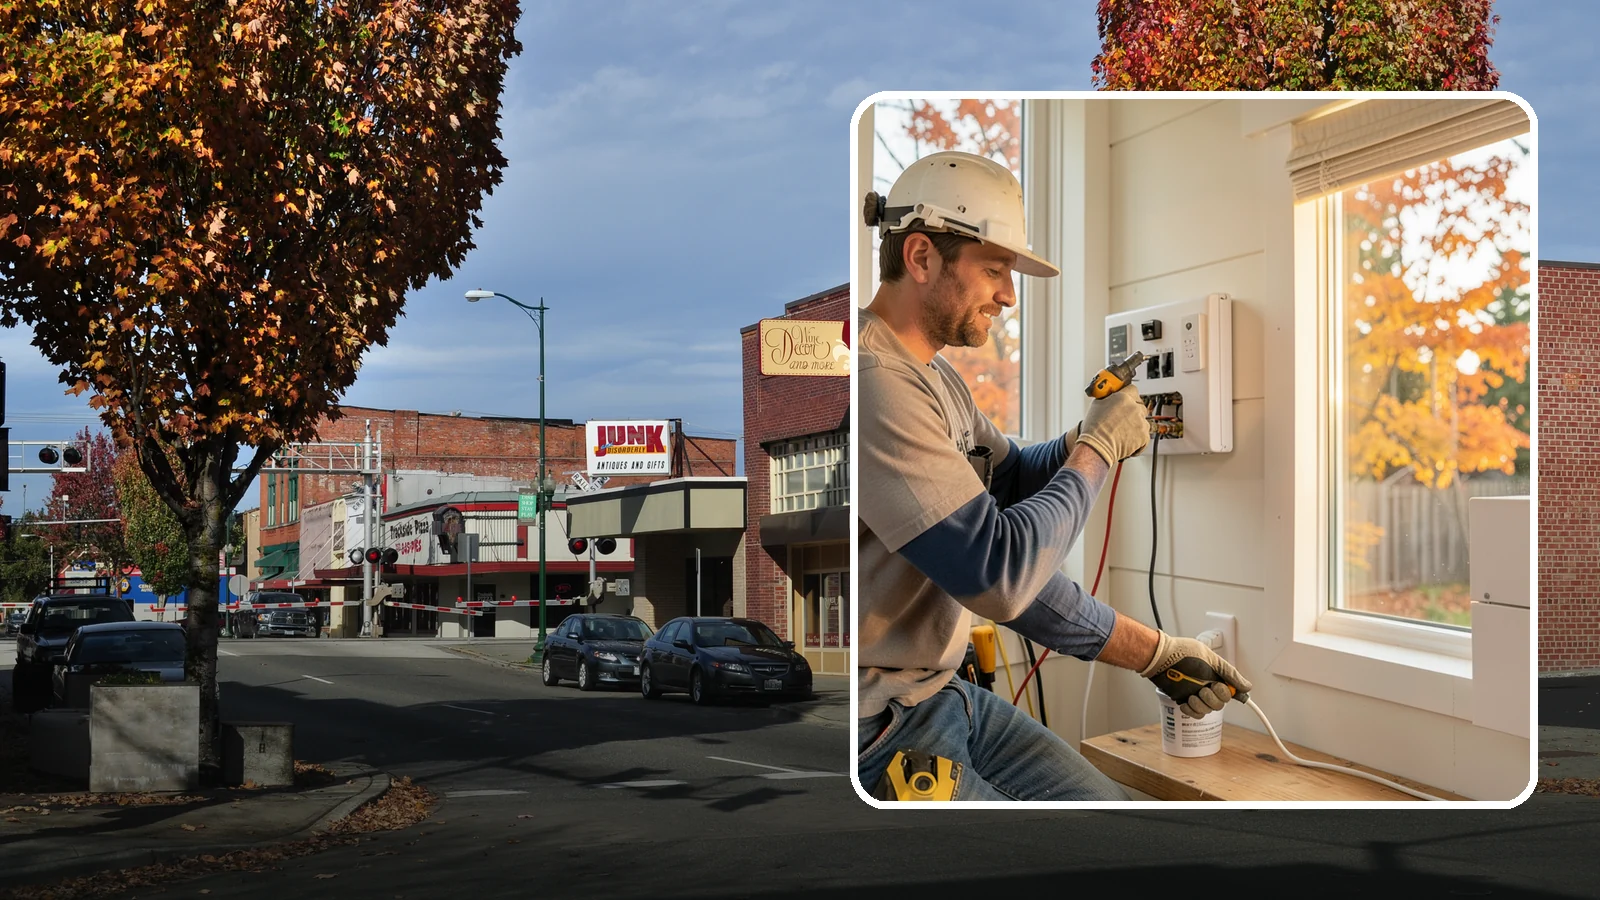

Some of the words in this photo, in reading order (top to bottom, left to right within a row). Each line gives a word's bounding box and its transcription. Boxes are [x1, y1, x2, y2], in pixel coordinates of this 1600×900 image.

[791, 325, 820, 344] Wine
[765, 328, 831, 365] Decor
[596, 425, 665, 457] JUNK
[597, 461, 628, 470] ANTIQUES
[631, 461, 644, 470] AND
[647, 461, 665, 470] GIFTS
[390, 521, 413, 540] Trackside
[414, 519, 429, 535] Pizza
